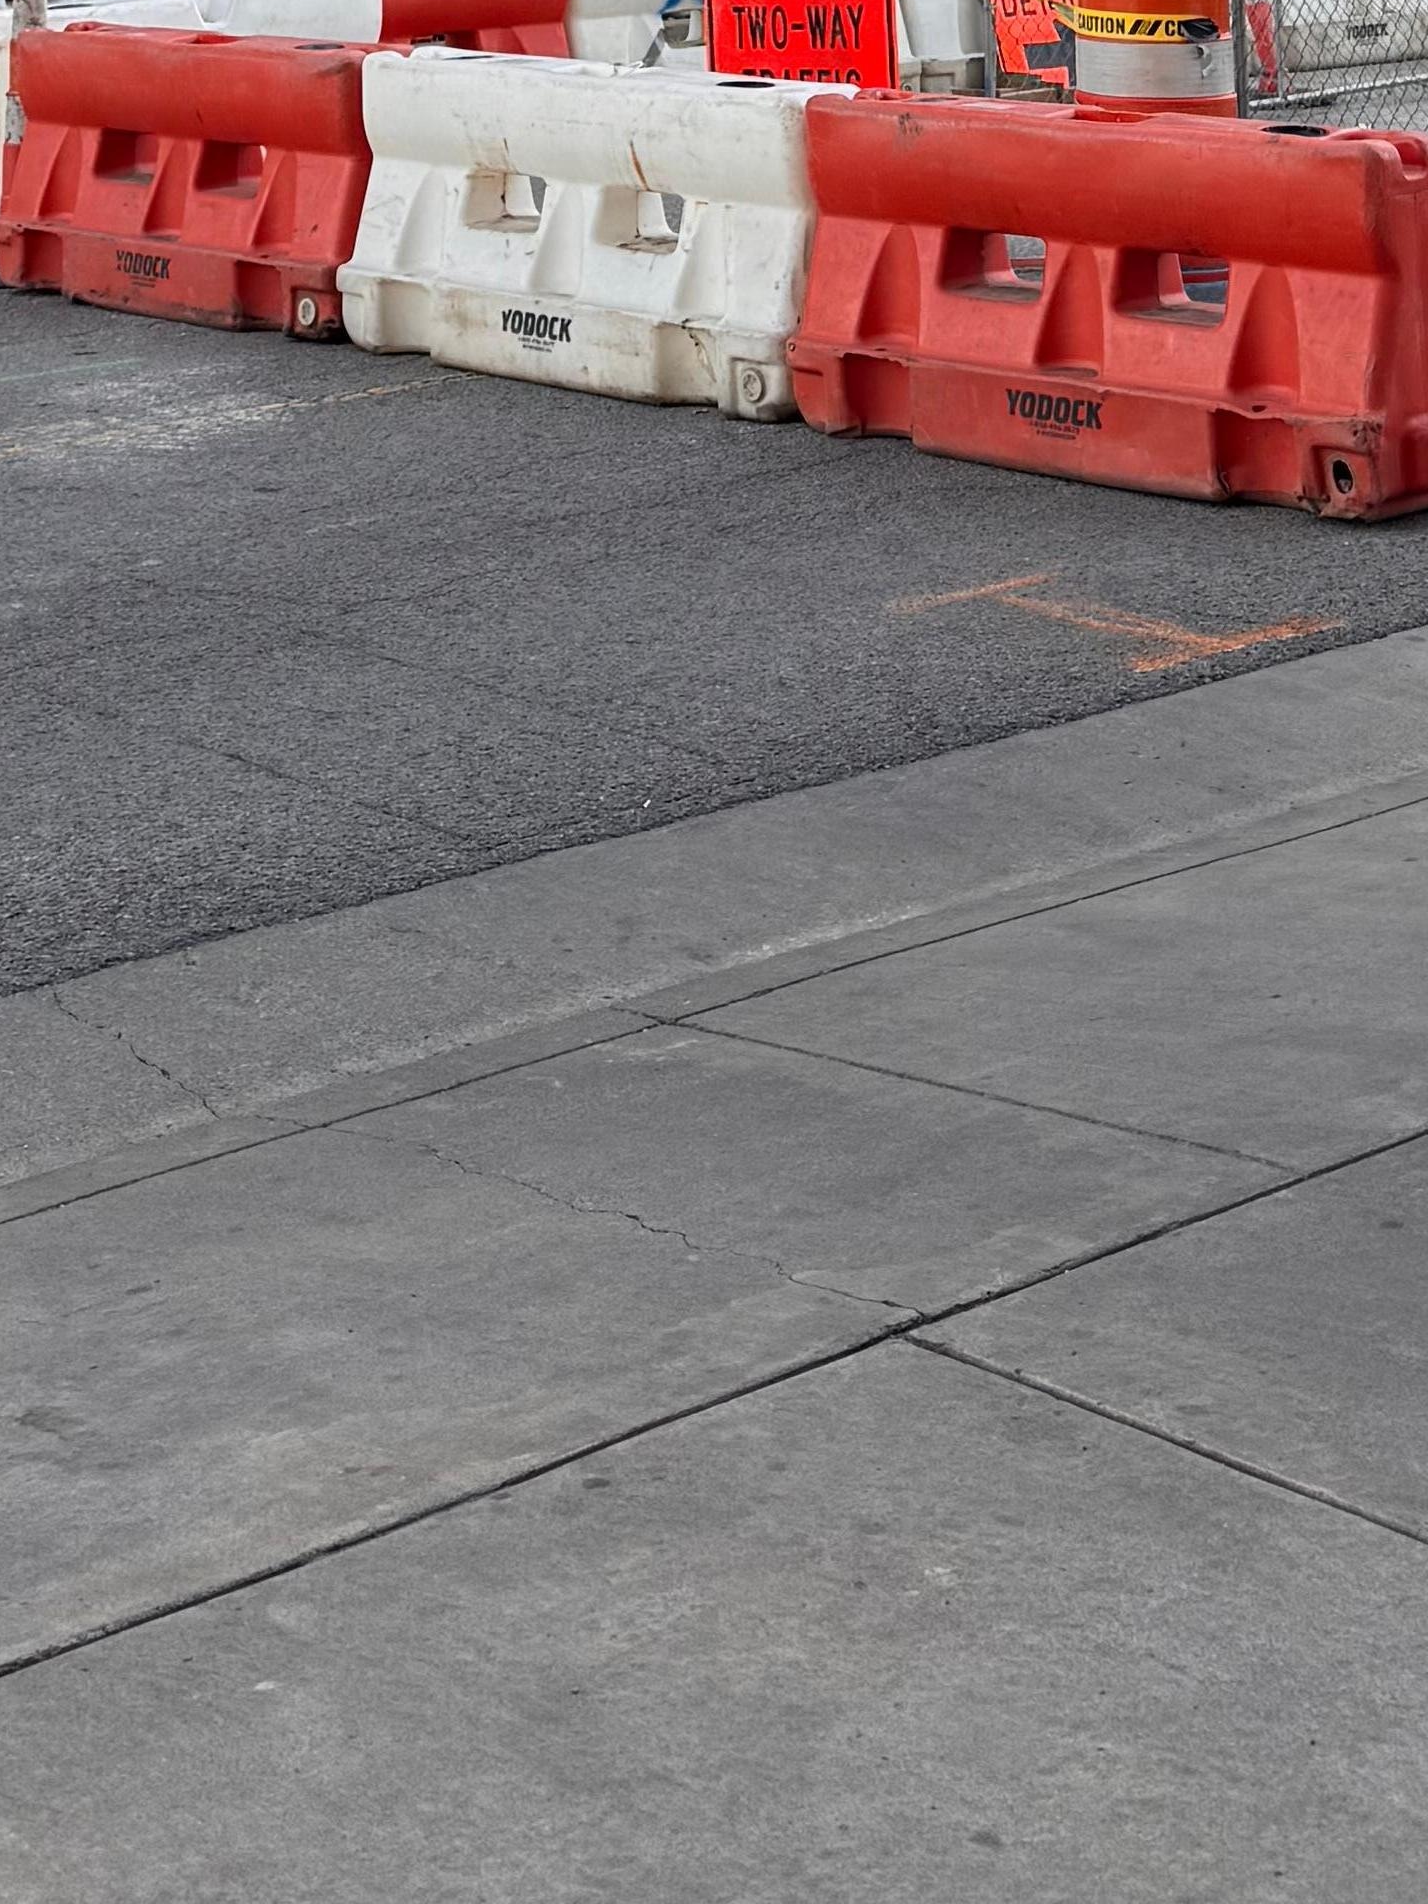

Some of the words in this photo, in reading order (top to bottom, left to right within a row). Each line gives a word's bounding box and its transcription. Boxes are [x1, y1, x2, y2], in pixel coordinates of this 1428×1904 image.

[732, 4, 864, 50] TWO-WAY
[116, 249, 171, 280] YODOCK
[502, 309, 572, 343] YODOCK
[1005, 388, 1103, 429] YODOCK
